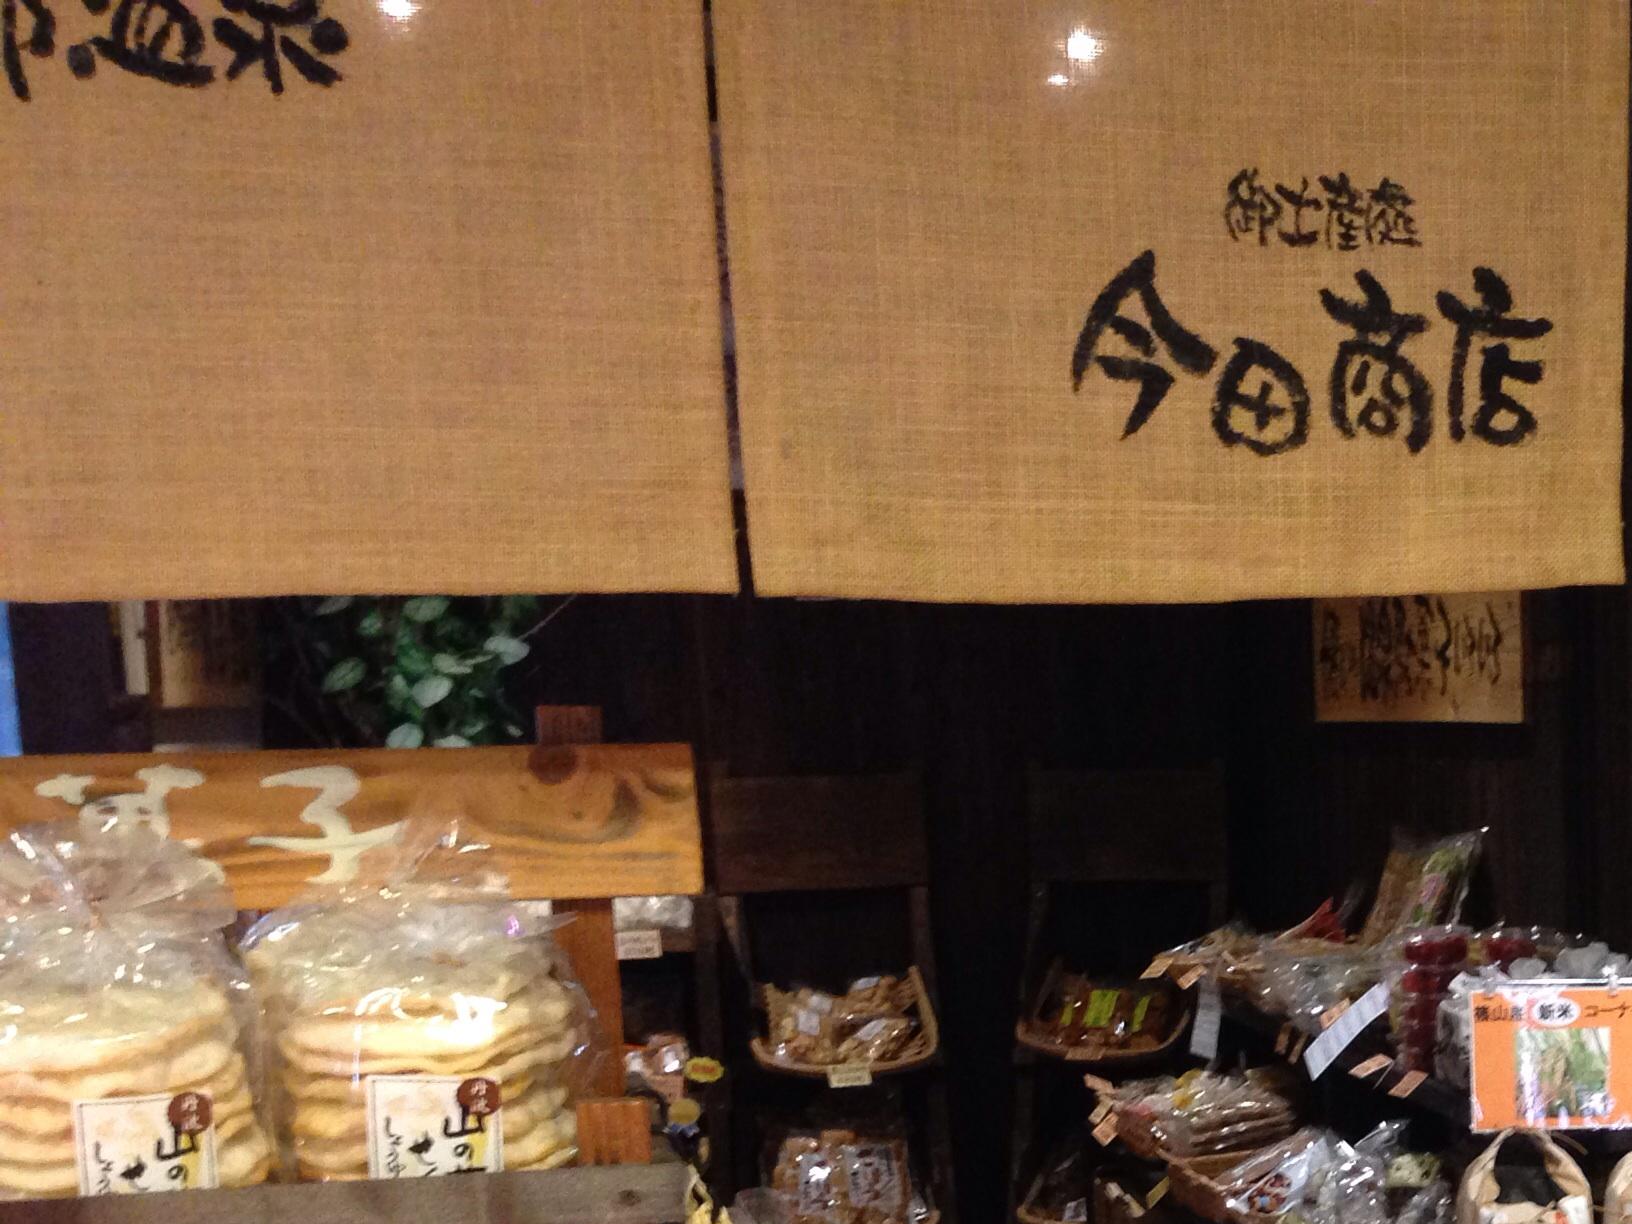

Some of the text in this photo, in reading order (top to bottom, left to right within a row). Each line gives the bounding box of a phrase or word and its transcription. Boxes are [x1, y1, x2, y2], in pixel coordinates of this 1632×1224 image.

[1072, 248, 1554, 457] 今田商店
[1538, 1003, 1574, 1020] 新米
